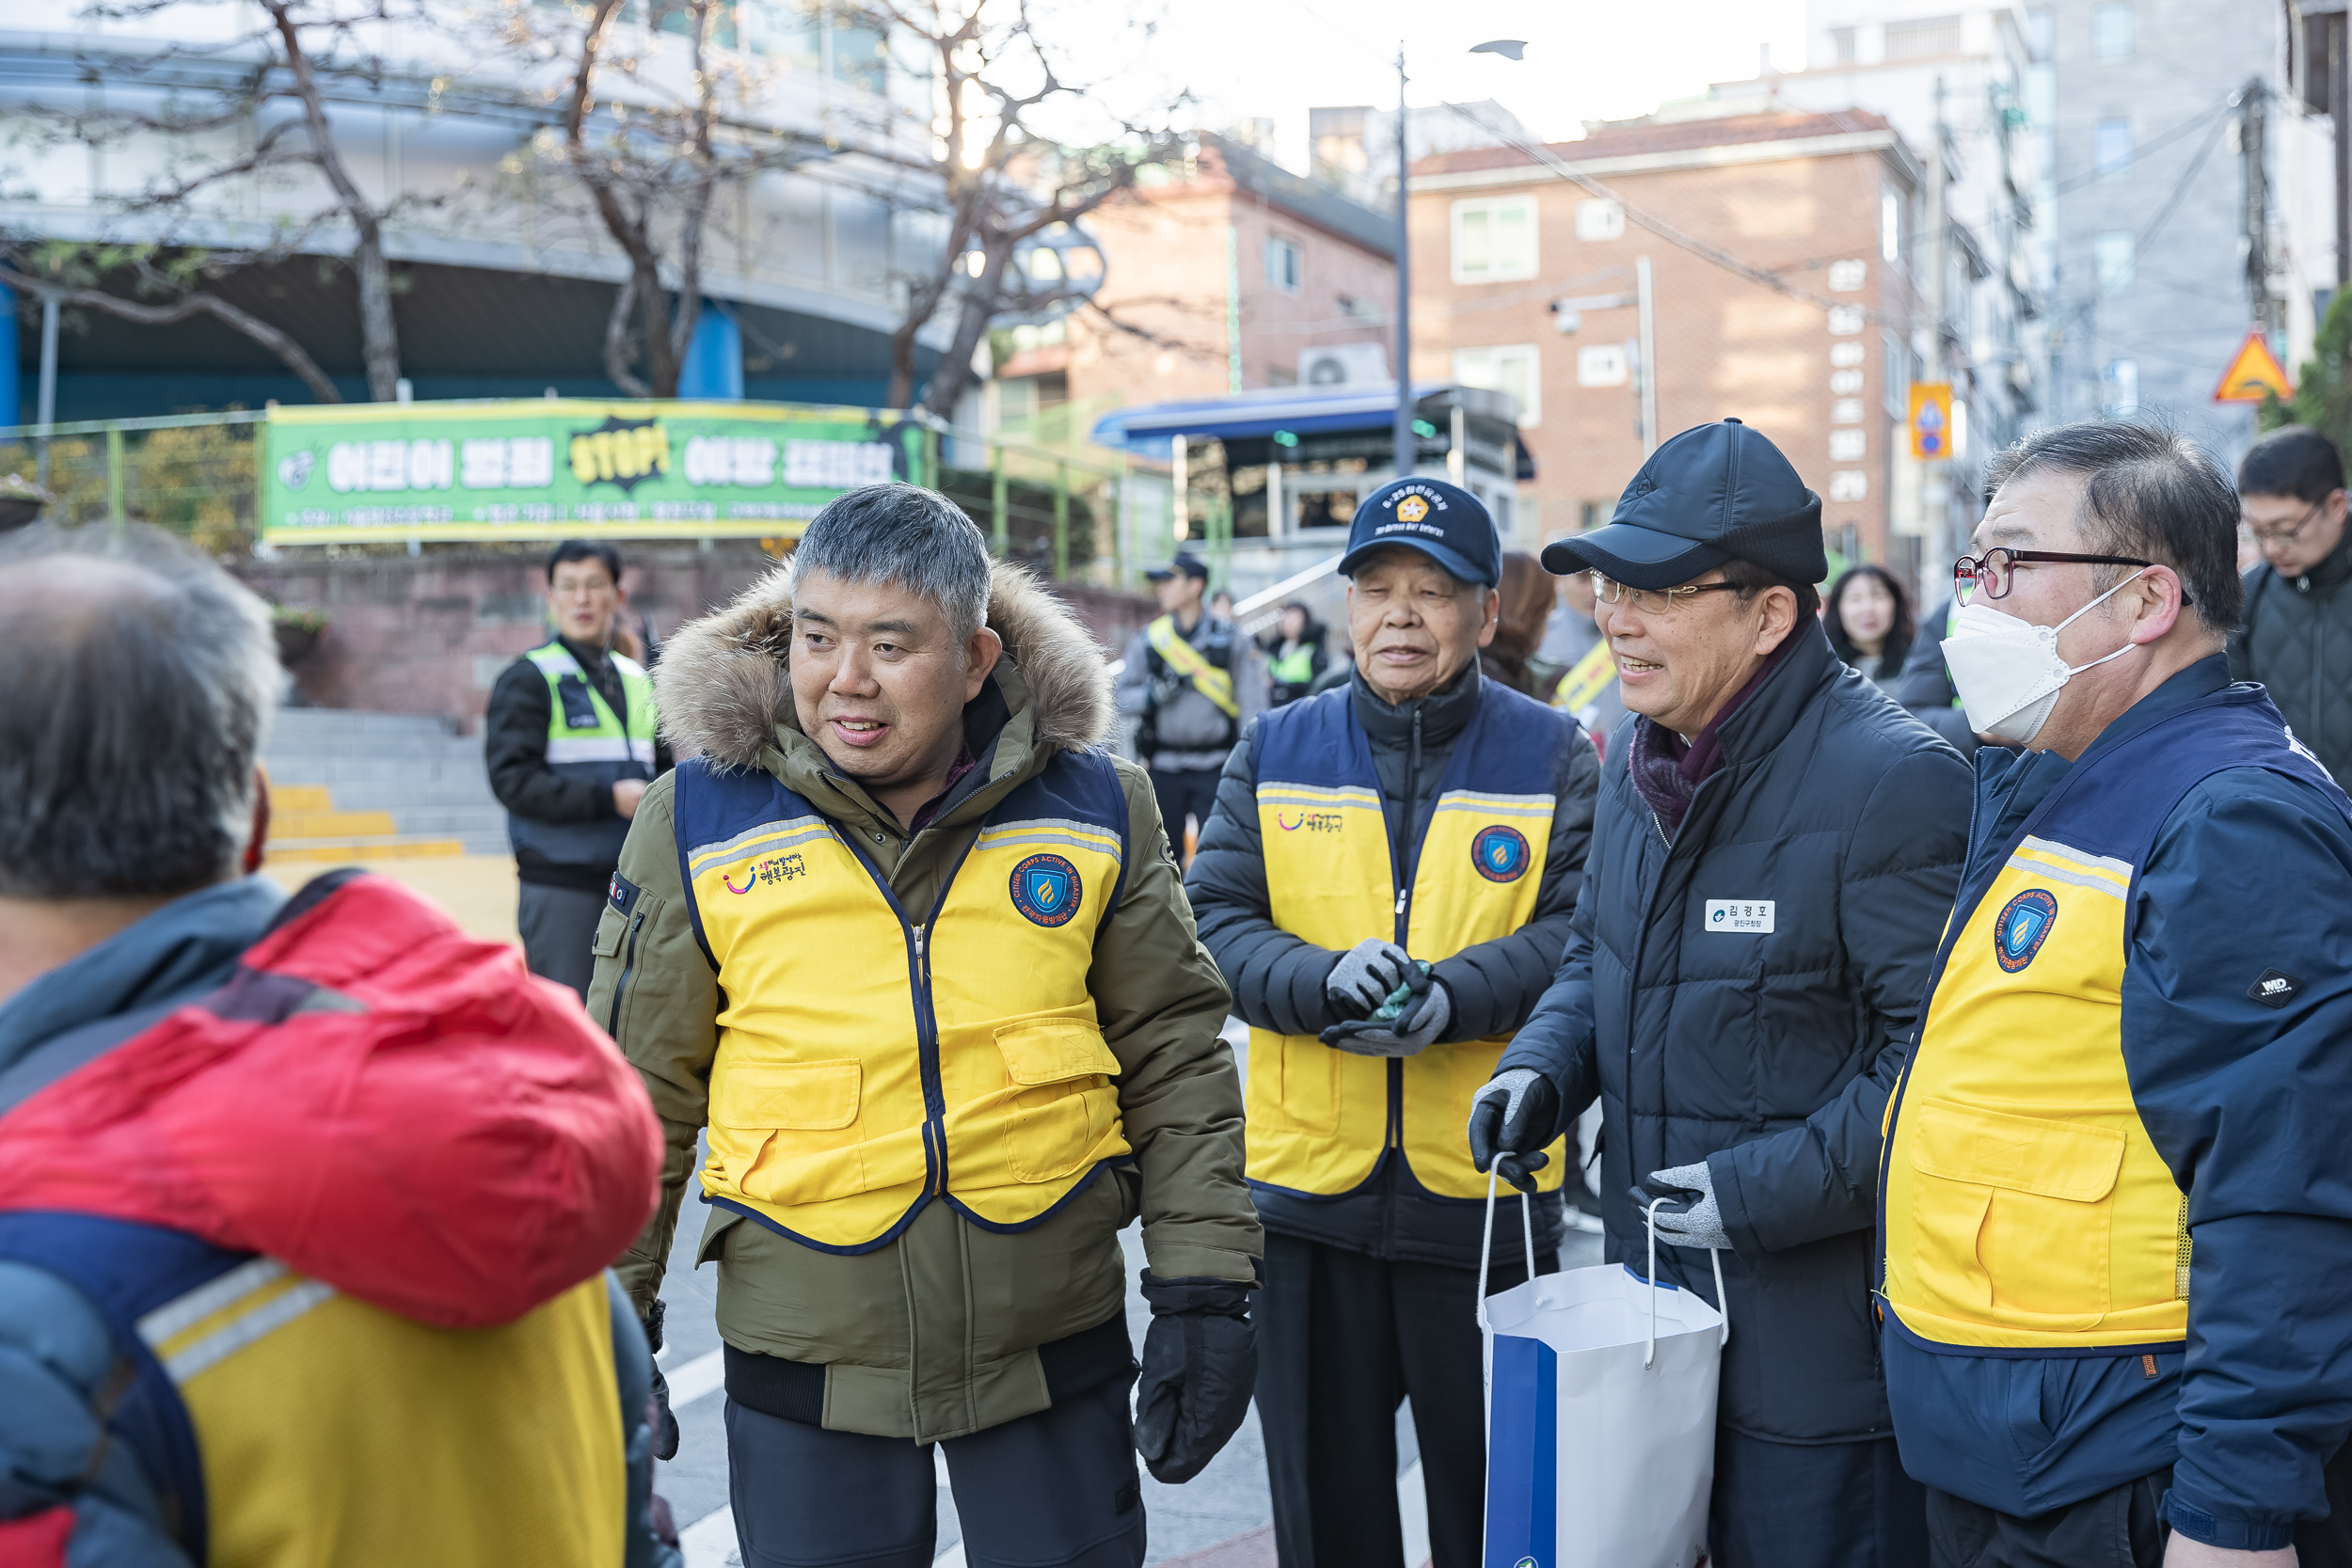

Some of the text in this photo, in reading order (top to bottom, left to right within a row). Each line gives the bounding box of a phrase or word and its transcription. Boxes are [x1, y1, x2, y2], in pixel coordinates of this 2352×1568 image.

[760, 862, 806, 885] 행복광진
[1012, 873, 1021, 897] CITIZEN
[1018, 857, 1039, 873] CORPS
[1041, 856, 1066, 867] ACTIVE
[1071, 876, 1079, 908] DISASTER
[2012, 892, 2035, 906] CORPS
[2035, 892, 2055, 908] ACTIVE
[1996, 906, 2011, 936] CITIZEN
[2032, 917, 2054, 950] DISASTER
